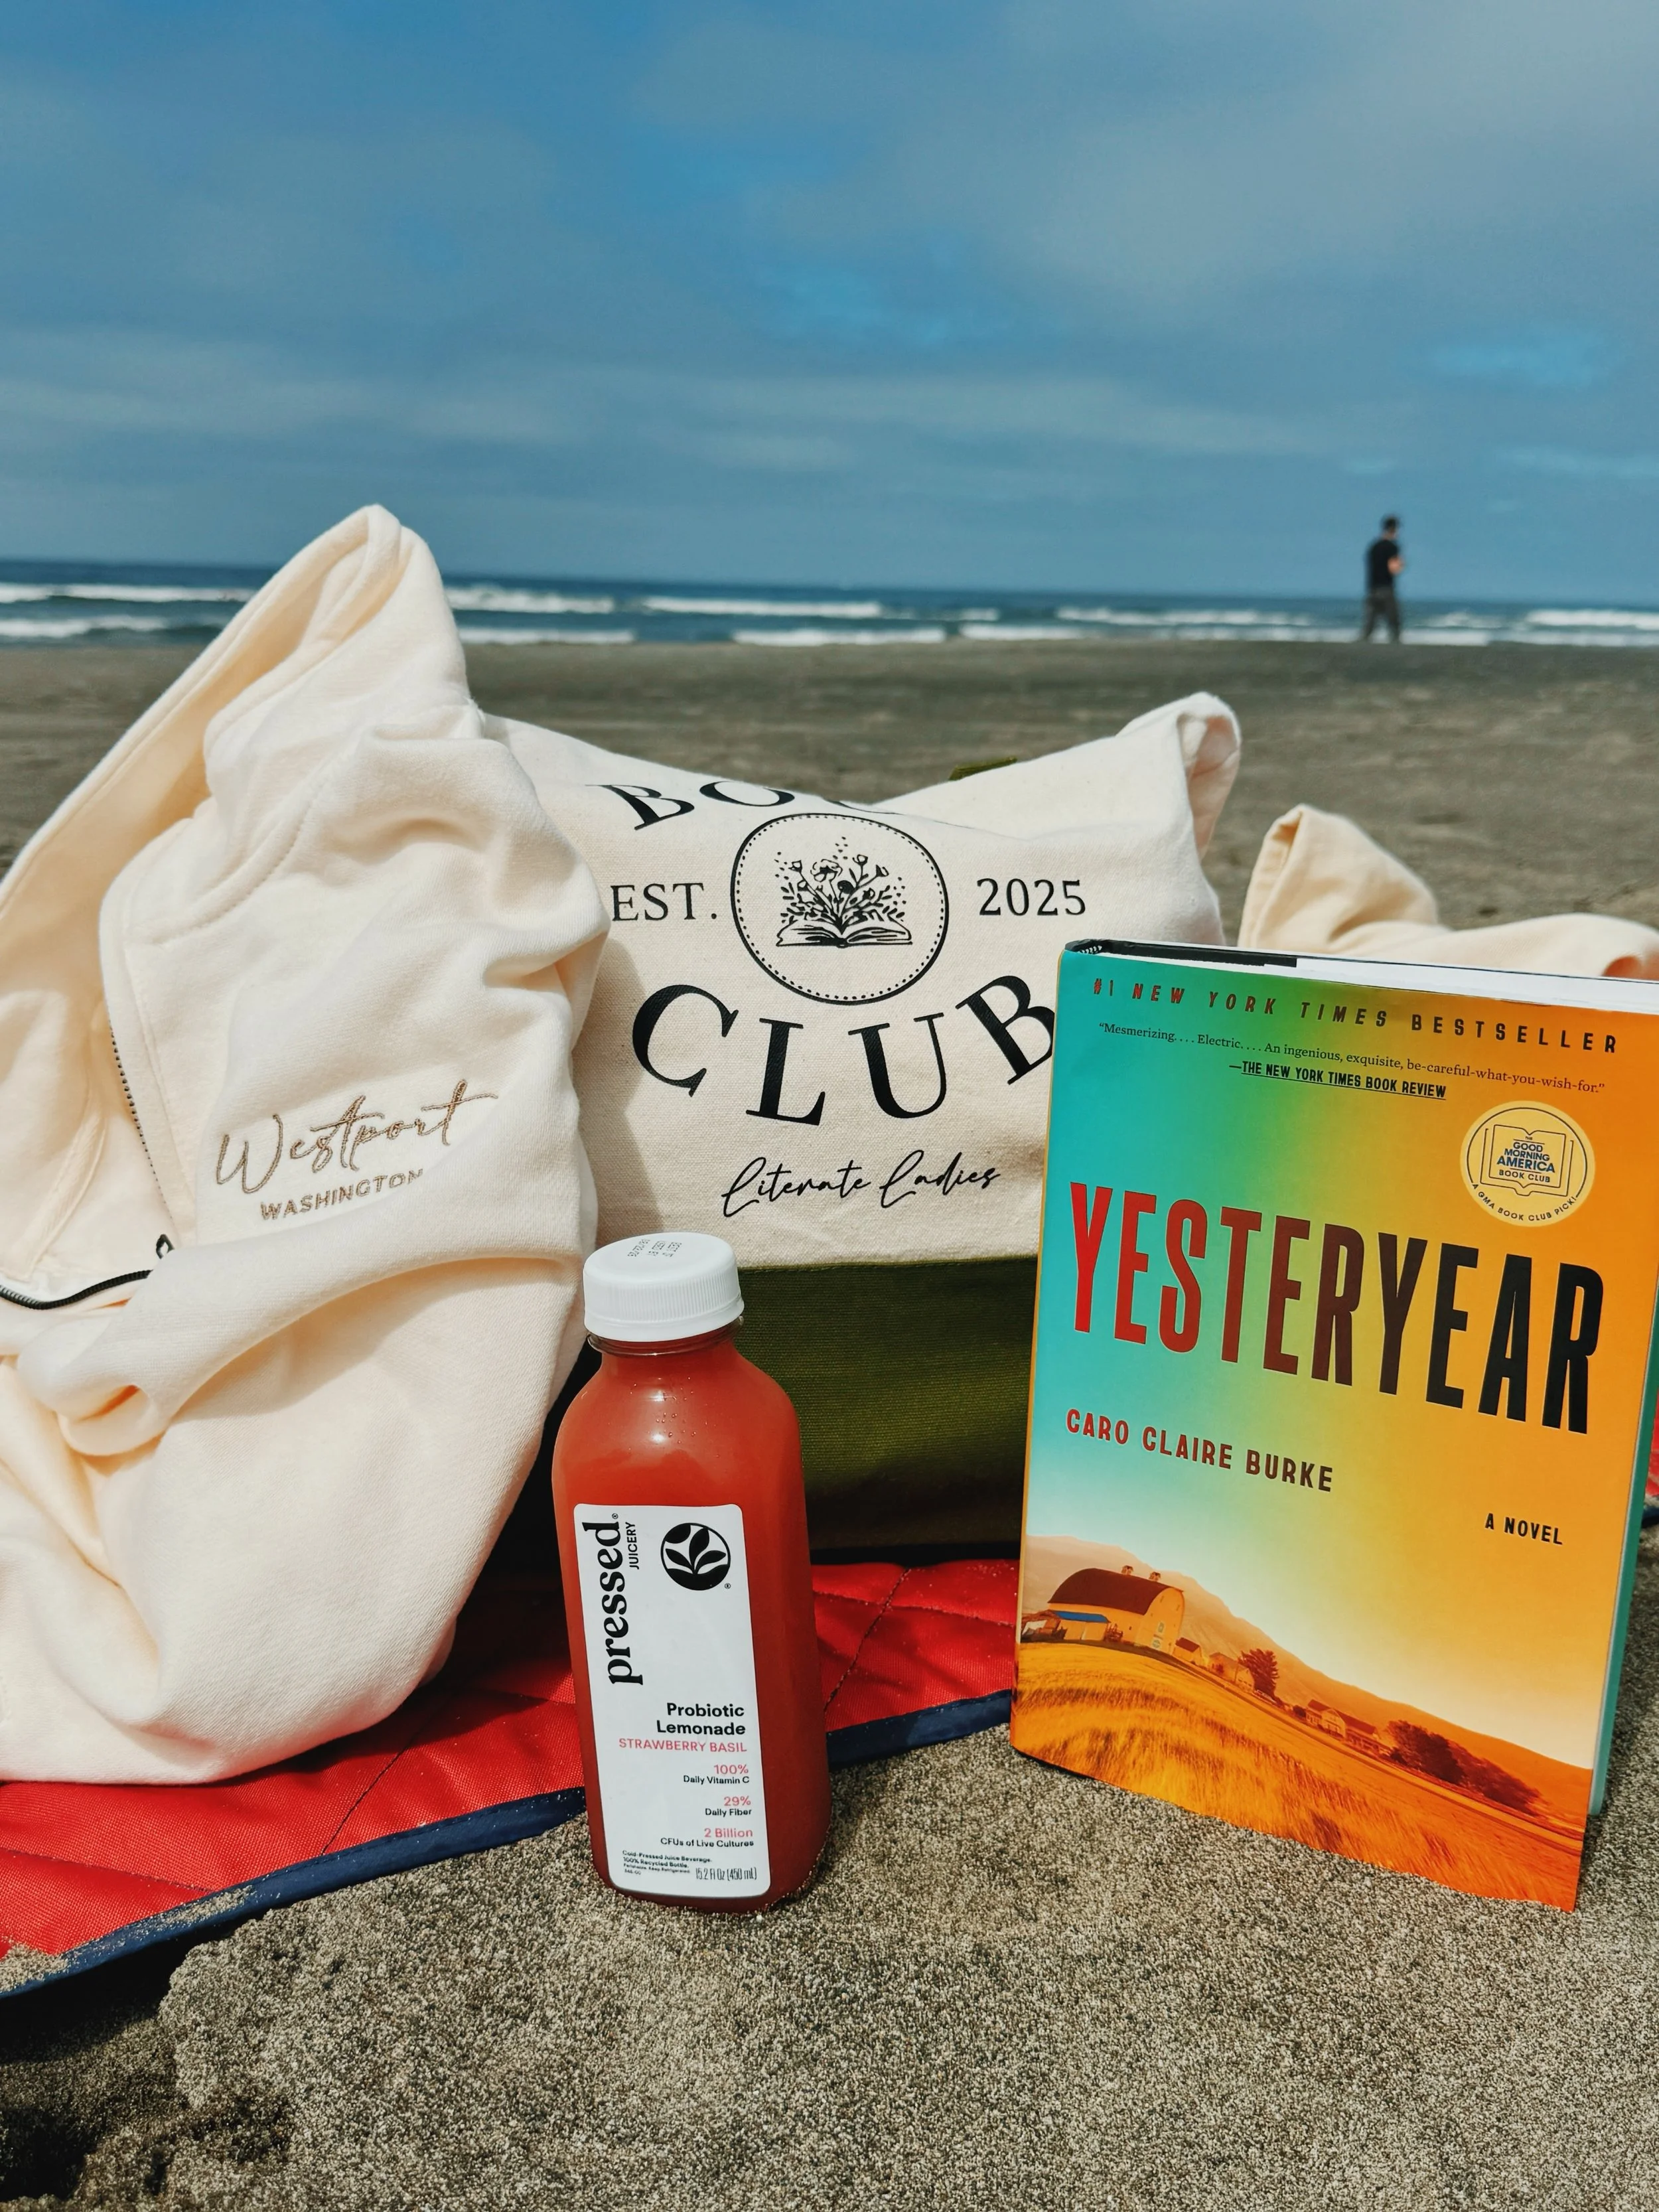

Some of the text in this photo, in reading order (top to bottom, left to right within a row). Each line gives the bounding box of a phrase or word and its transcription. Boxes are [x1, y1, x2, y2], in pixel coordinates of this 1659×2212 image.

[611, 878, 1086, 922] EST. 2025
[1094, 979, 1617, 1053] #1 NEW YORK TIMES BESTSELLER
[632, 975, 1056, 1126] CLUB
[1264, 1043, 1281, 1053] An
[1283, 1043, 1343, 1063] ingenious,
[1346, 1053, 1404, 1070] exquisite,
[1266, 1064, 1290, 1078] NEW
[1295, 1067, 1323, 1082] YORK
[1329, 1071, 1361, 1087] TIMES
[1366, 1078, 1397, 1092] BOOK
[1402, 1082, 1447, 1098] REVIEW
[216, 1078, 498, 1193] Westport
[1504, 1148, 1550, 1161] MORNING
[1513, 1142, 1543, 1153] GOOD
[1496, 1155, 1555, 1173] AMERICA
[721, 1149, 1000, 1217] Literate Ladies
[1499, 1169, 1551, 1183] BOOK CLUB
[260, 1168, 423, 1220] WASHINGTON
[1479, 1191, 1495, 1209] GMA
[1498, 1207, 1524, 1220] BOOK
[1528, 1212, 1552, 1221] CLUB
[1554, 1196, 1577, 1215] PICK!
[1070, 1181, 1605, 1435] YESTERYEAR
[1066, 1408, 1334, 1492] CARO CLAIRE BURKE
[1484, 1513, 1563, 1546] A NOVEL
[625, 1522, 640, 1570] JUICERY
[582, 1521, 644, 1685] pressed
[667, 1702, 745, 1718] Probiotic
[656, 1720, 746, 1735] Lemonade
[618, 1737, 747, 1753] STRAWBERRY BASIL
[683, 1775, 705, 1785] Daily
[714, 1765, 749, 1775] 100%
[723, 1796, 751, 1806] 29%
[705, 1808, 727, 1818] Daily
[660, 1837, 684, 1846] CFUs
[704, 1828, 753, 1838] 2 Billion
[727, 1868, 743, 1881] (450
